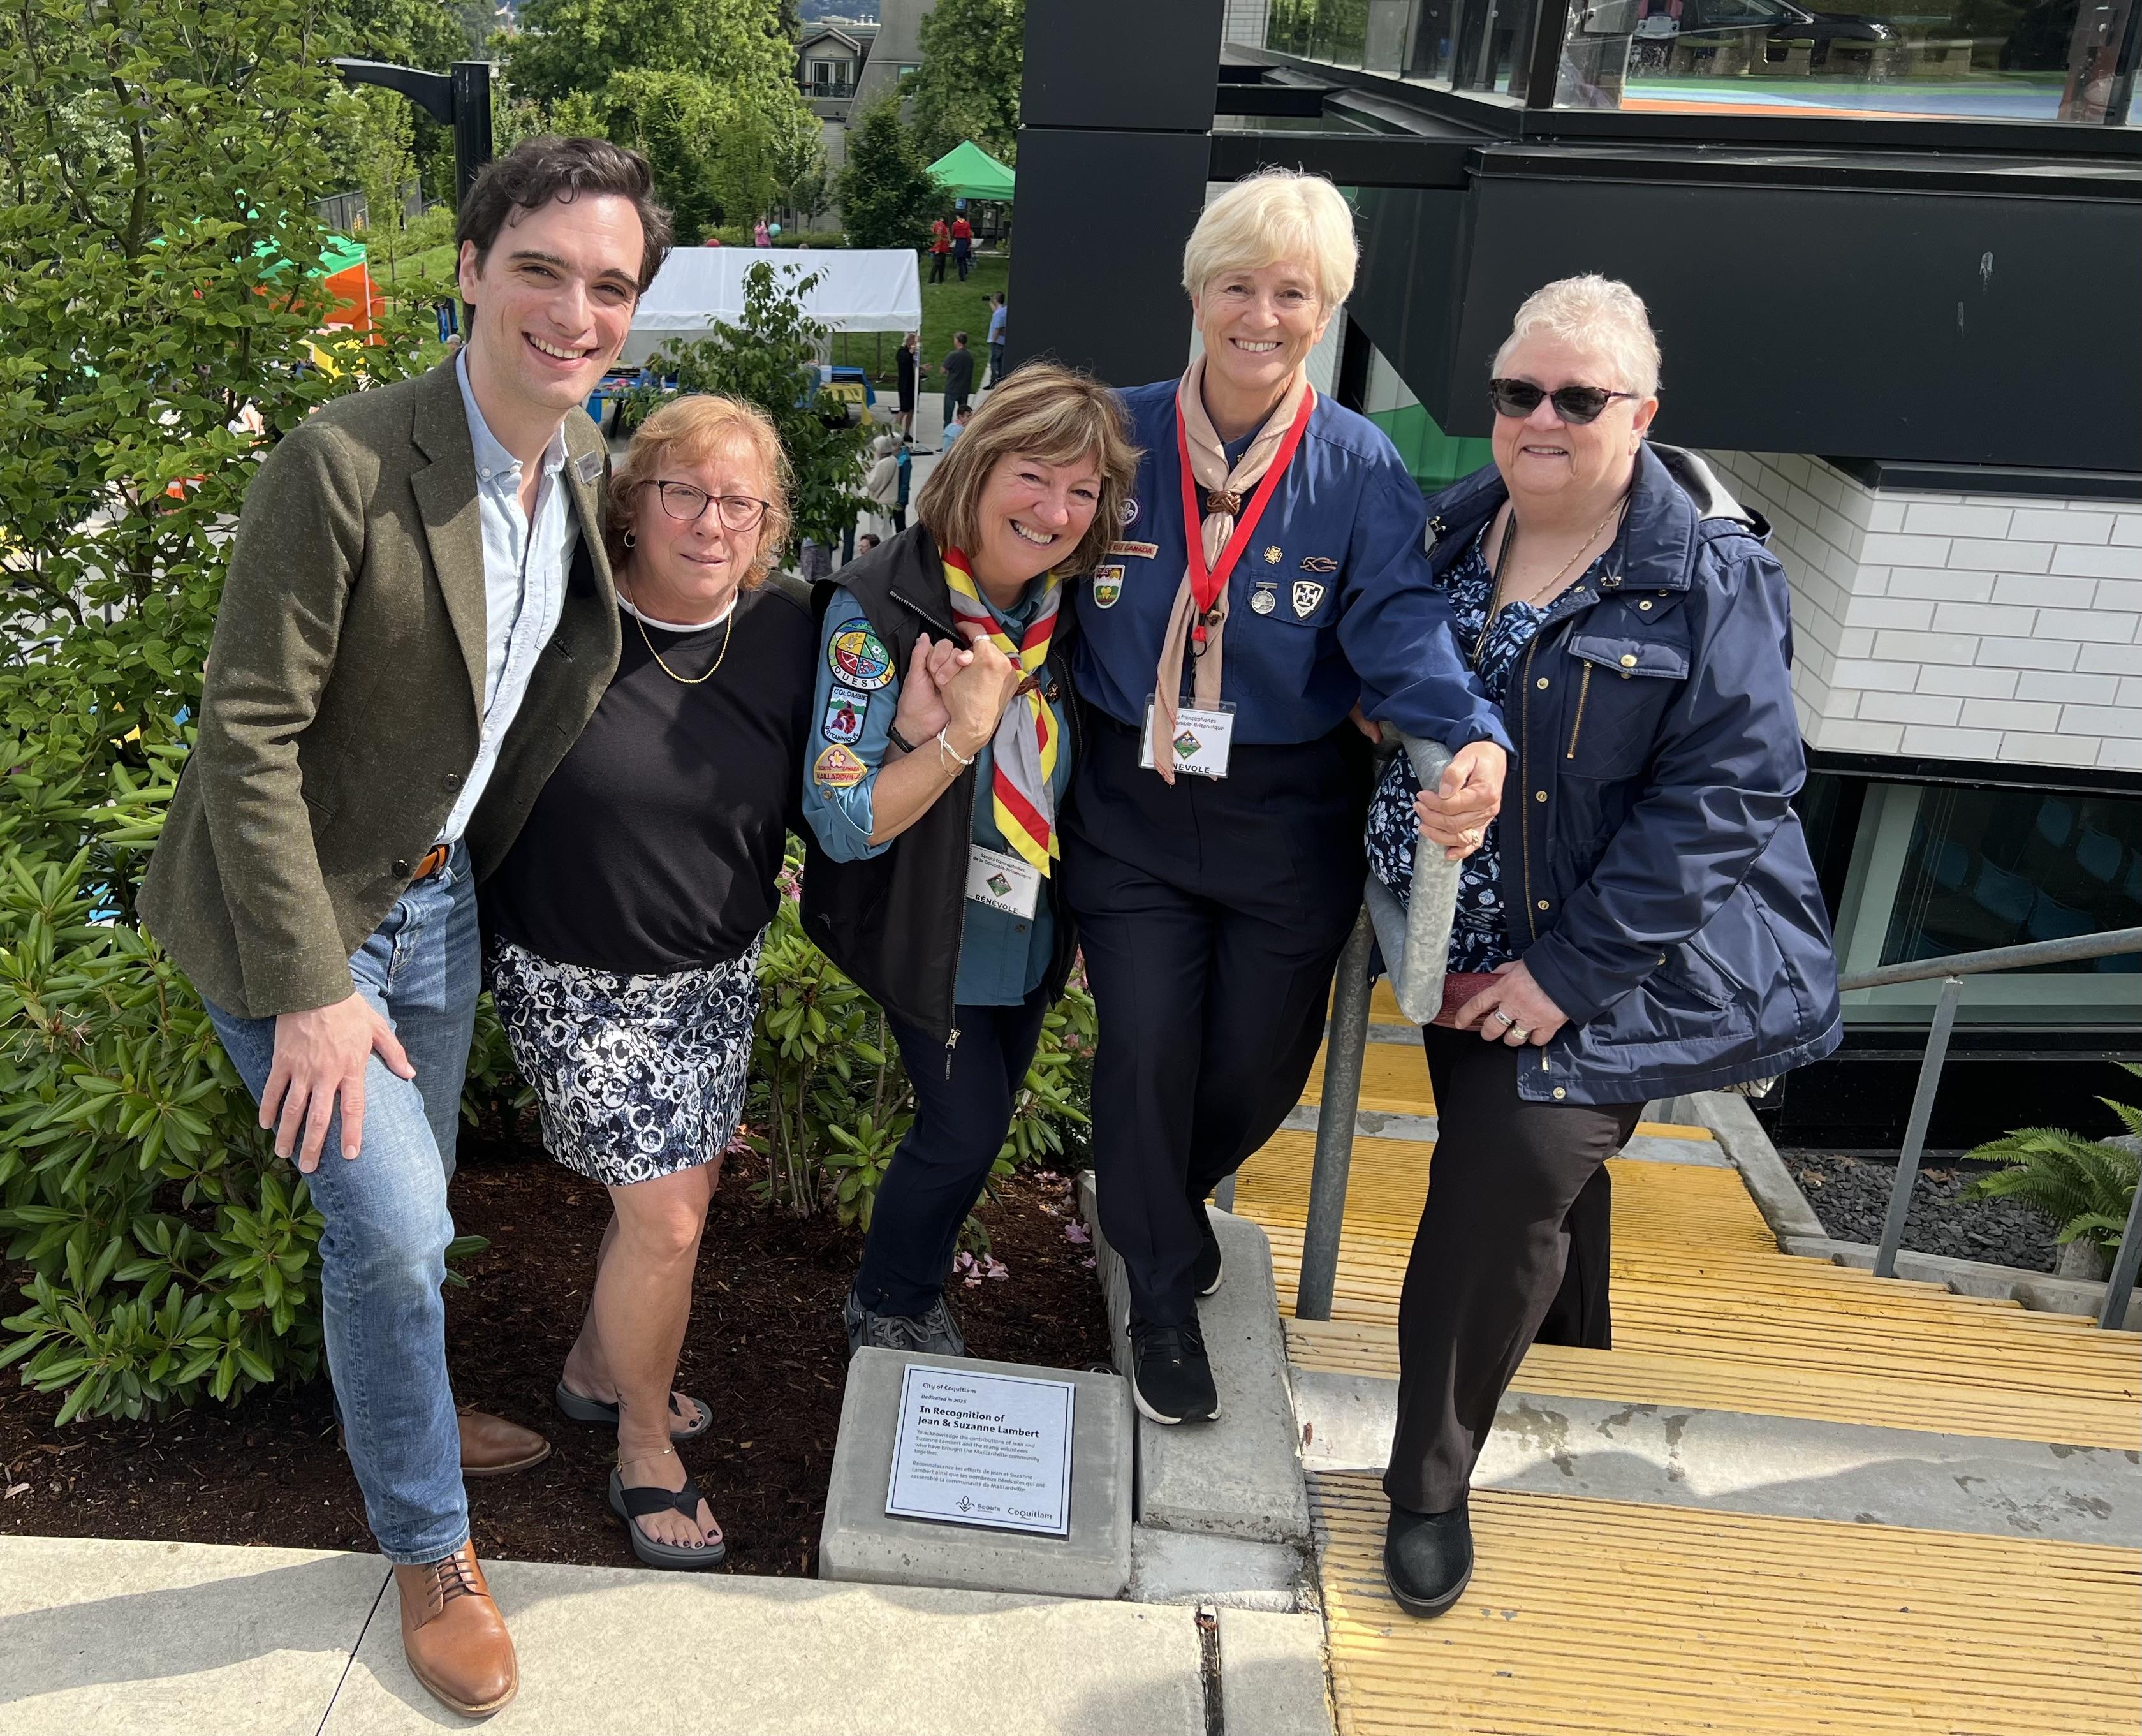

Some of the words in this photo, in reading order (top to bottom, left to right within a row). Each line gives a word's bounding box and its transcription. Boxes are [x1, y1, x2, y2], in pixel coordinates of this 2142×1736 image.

[1124, 545, 1152, 554] CANADA
[835, 666, 877, 688] OUEST
[834, 688, 867, 701] COLOMBIE
[1181, 714, 1217, 724] francophones
[1173, 762, 1210, 774] NÉVOLE
[981, 853, 995, 862] Scouts
[995, 858, 1025, 872] francophones
[974, 894, 1019, 915] BÉNÉVOLE
[944, 1385, 976, 1394] Coquitlam
[920, 1405, 930, 1413] In
[933, 1407, 992, 1421] Recognition
[918, 1416, 939, 1425] Jean
[942, 1418, 951, 1427] &
[953, 1420, 995, 1432] Suzanne
[998, 1425, 1039, 1438] Lambert
[924, 1431, 958, 1439] acknowledge
[969, 1436, 1004, 1445] contributions
[974, 1449, 1008, 1458] Maillardville
[1008, 1453, 1040, 1463] community
[913, 1460, 955, 1471] Reconnaissance
[946, 1478, 982, 1487] communauté
[997, 1477, 1025, 1486] bénévoles
[977, 1503, 1001, 1512] Scouts
